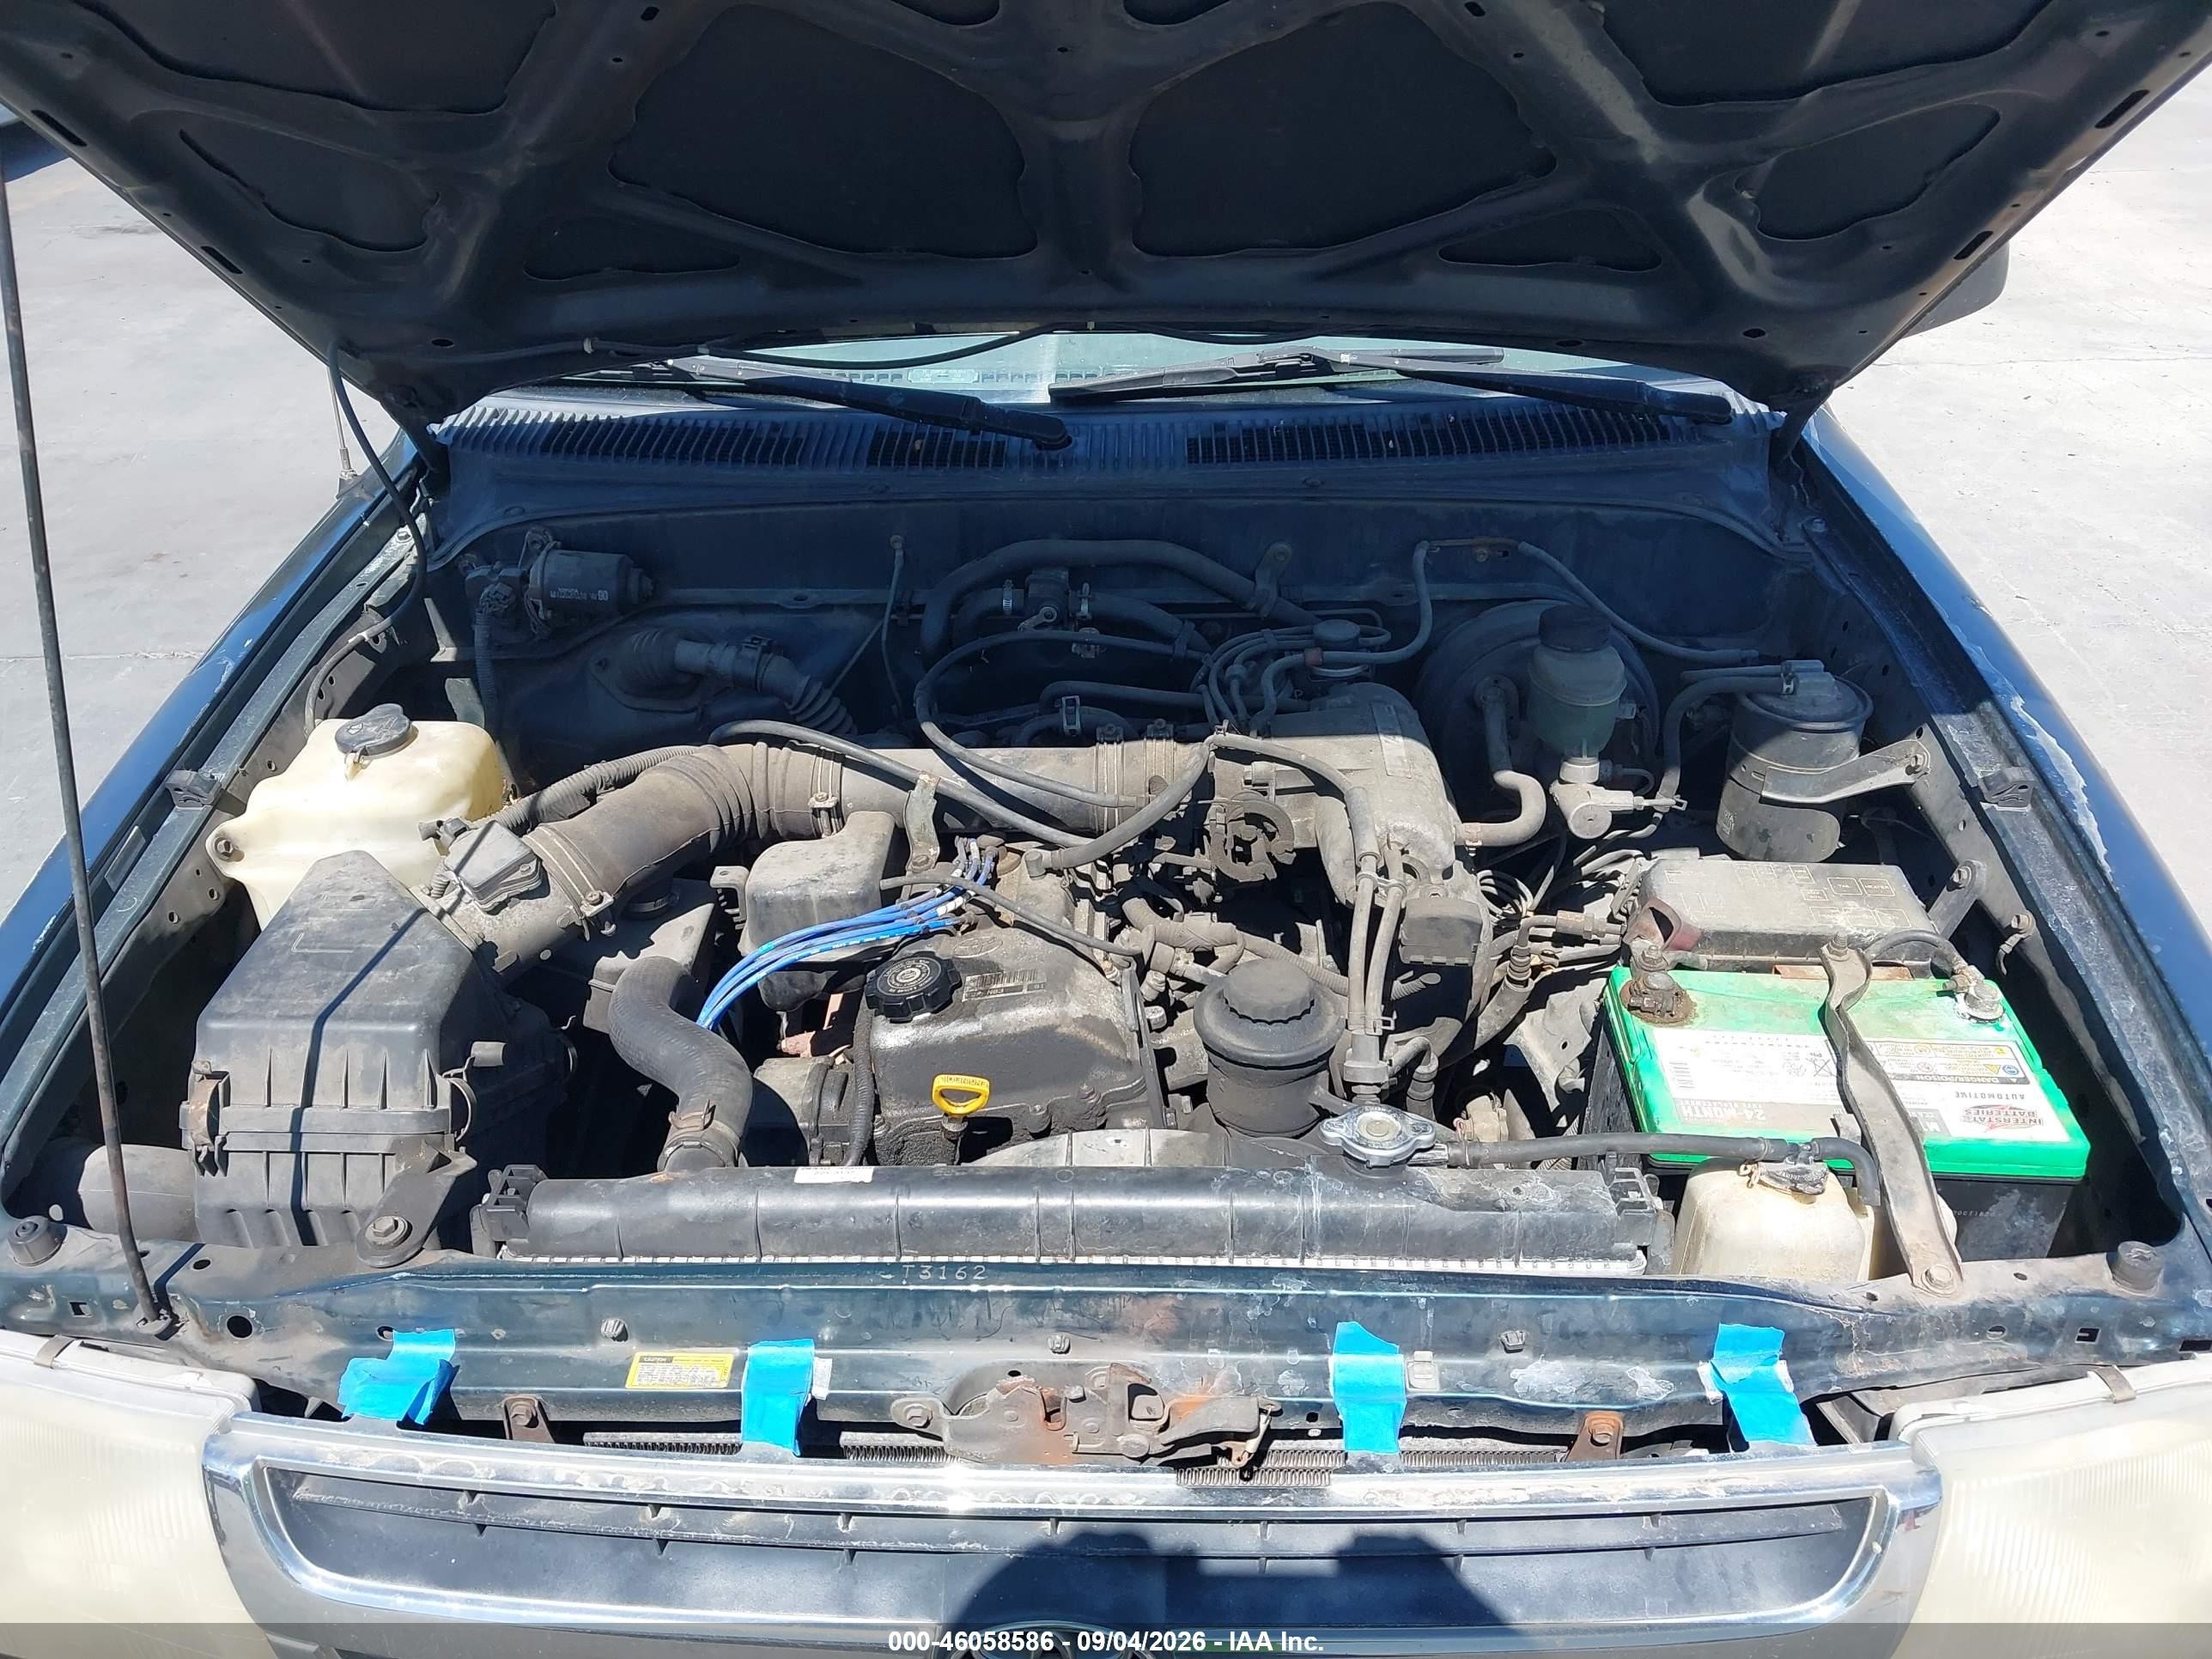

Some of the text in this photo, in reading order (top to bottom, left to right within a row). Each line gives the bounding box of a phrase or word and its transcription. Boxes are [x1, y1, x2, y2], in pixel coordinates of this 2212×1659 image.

[1915, 1075, 2000, 1084] DANGER/POISON
[1954, 1091, 2026, 1101] AUTOMOTIVE
[1680, 1104, 1766, 1121] 24-MONTH
[1963, 1108, 2038, 1118] BATTERIES
[1962, 1115, 2043, 1126] INTERSTATE
[902, 1264, 988, 1281] T3162
